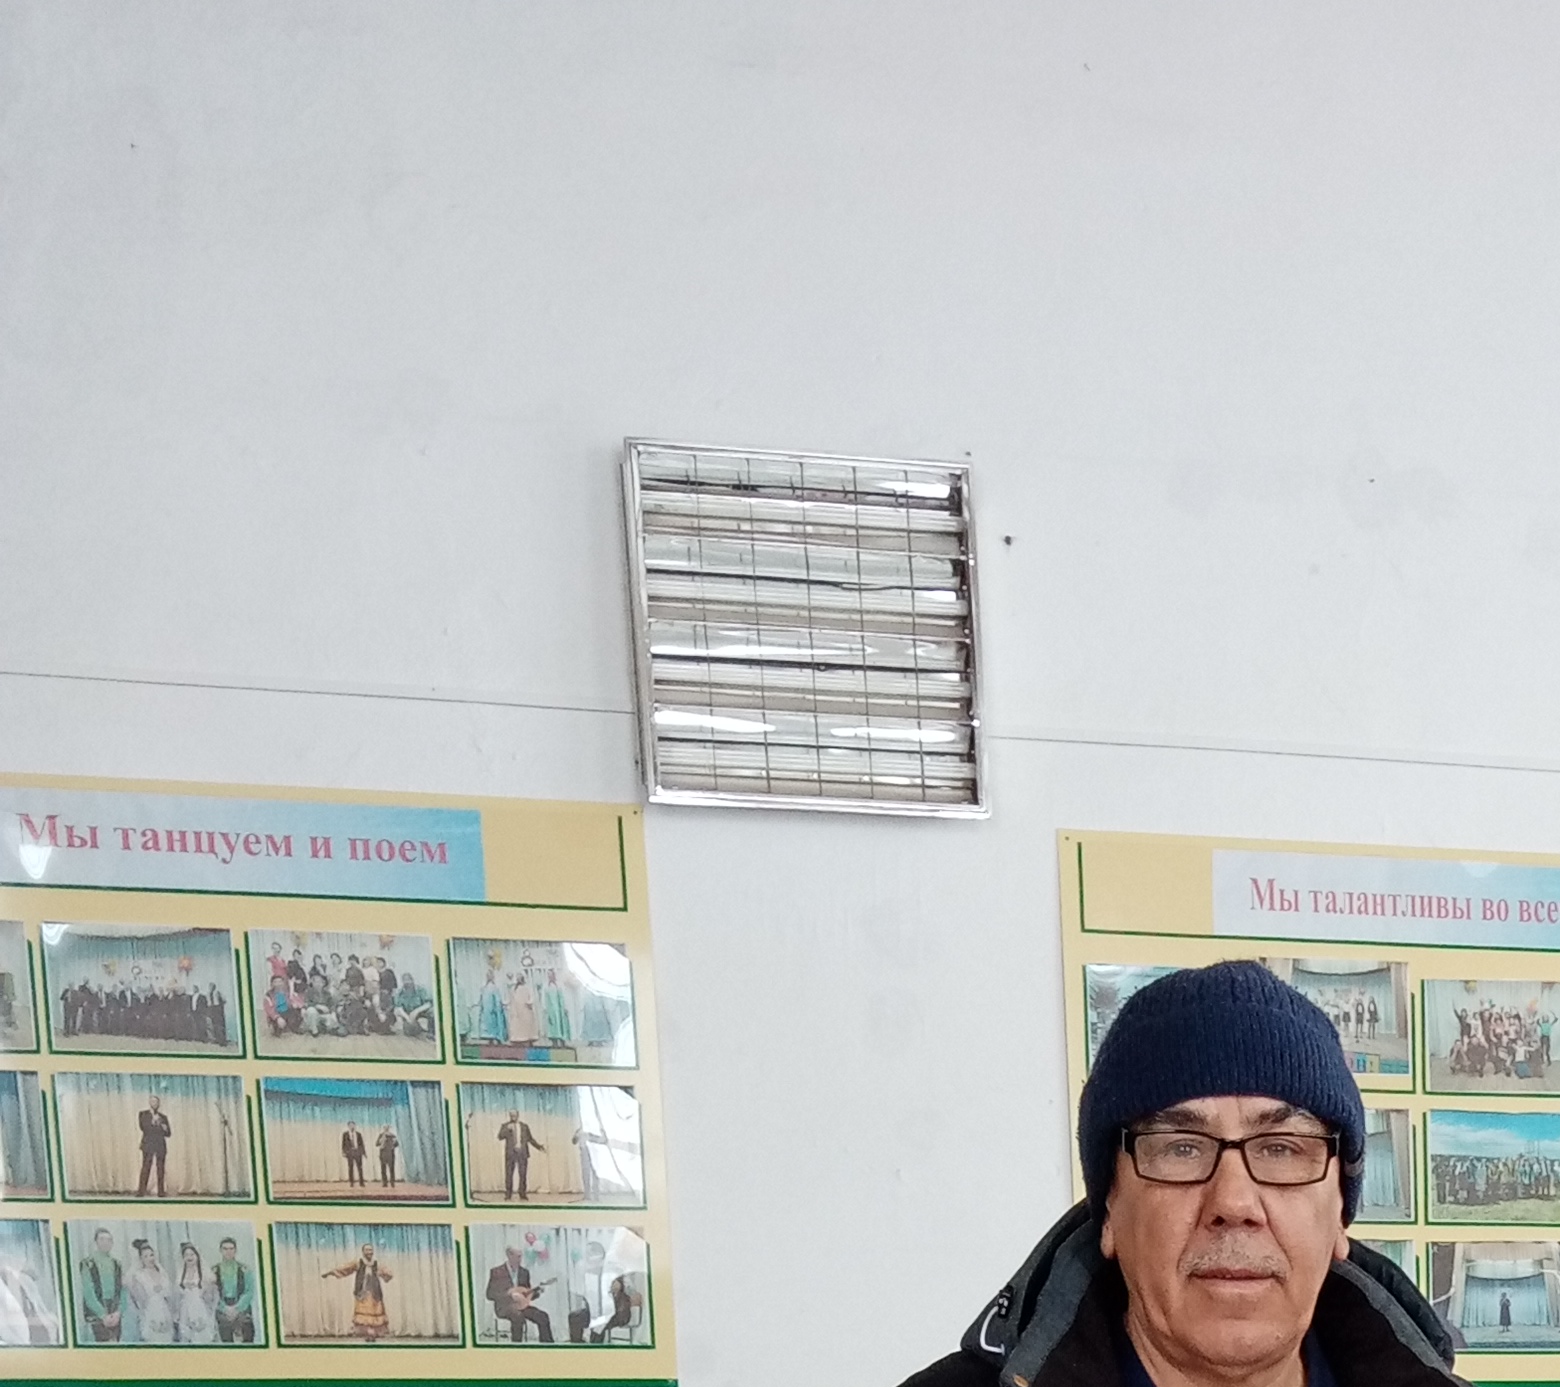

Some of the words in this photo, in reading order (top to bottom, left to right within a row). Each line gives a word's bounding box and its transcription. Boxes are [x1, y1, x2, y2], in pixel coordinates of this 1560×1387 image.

[16, 812, 100, 850] Мы
[113, 825, 293, 864] танцуем
[309, 835, 334, 860] и
[347, 836, 449, 865] поем
[1249, 877, 1301, 912] Мы
[1308, 889, 1472, 921] талантливы
[1481, 897, 1509, 922] во
